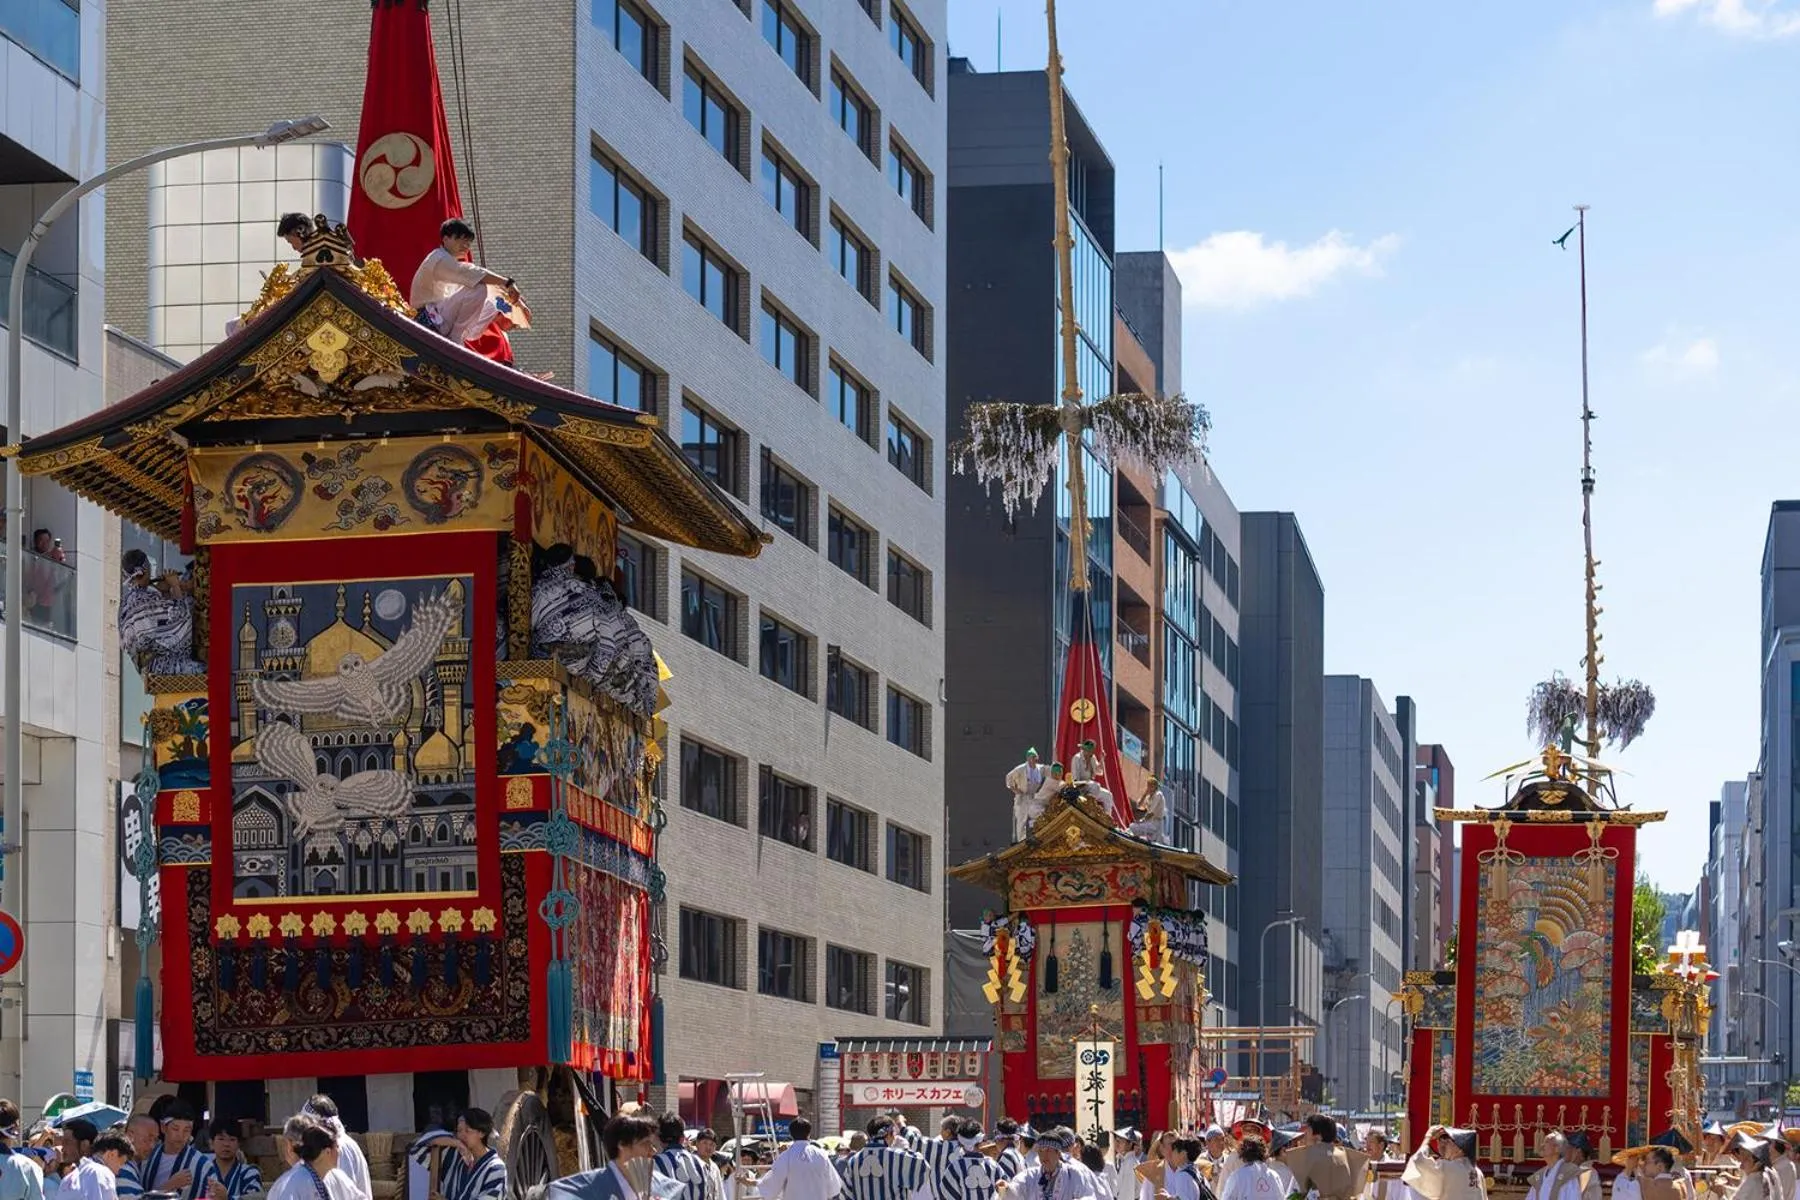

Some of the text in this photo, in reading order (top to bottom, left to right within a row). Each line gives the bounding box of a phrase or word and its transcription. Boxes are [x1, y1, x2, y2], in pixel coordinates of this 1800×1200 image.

[882, 1087, 963, 1100] ホリーズカフェ
